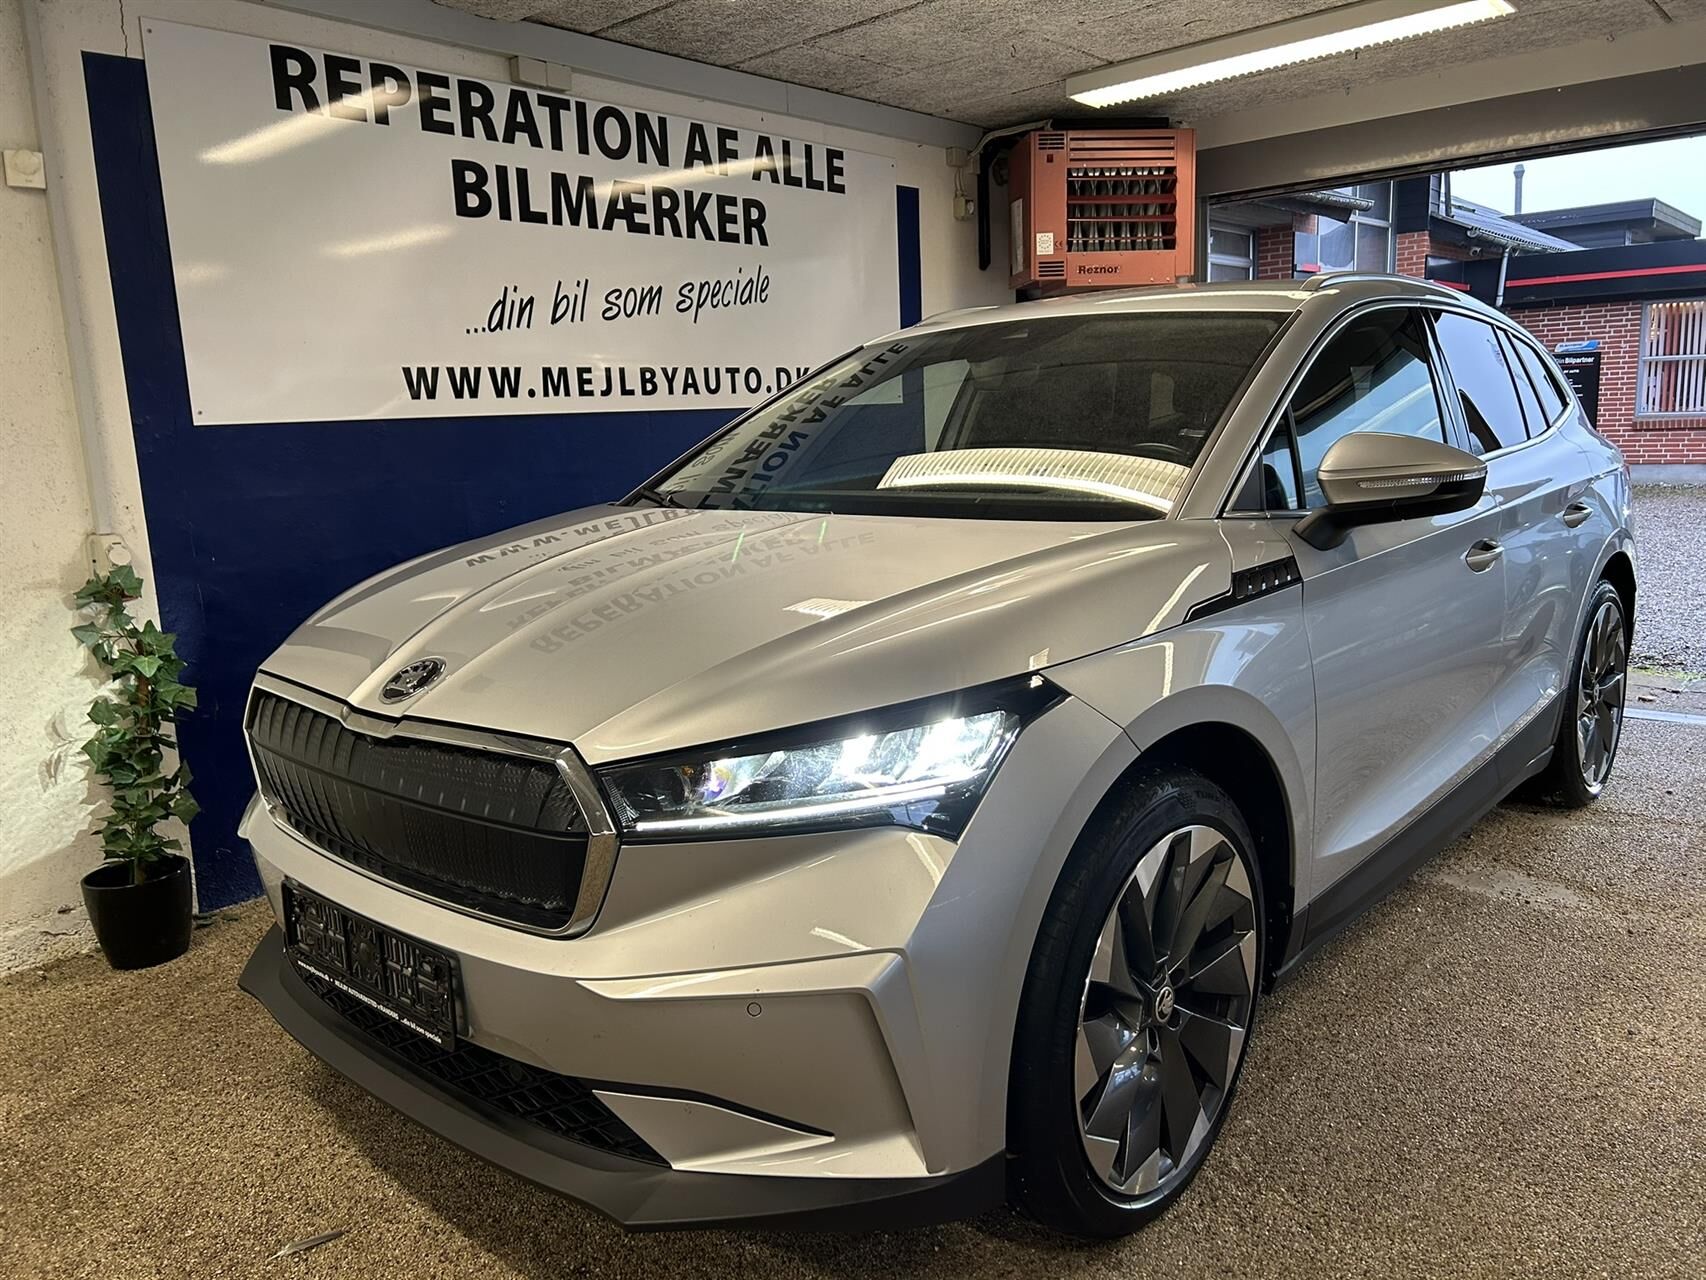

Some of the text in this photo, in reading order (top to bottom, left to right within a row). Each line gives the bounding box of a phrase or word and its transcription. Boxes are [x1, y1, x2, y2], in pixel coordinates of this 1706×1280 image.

[269, 44, 846, 195] REPERATION AF ALLE
[451, 159, 769, 247] BILMÆRKER
[550, 278, 589, 326] bil
[601, 285, 663, 321] som
[675, 264, 770, 324] speciale
[1077, 264, 1120, 275] Reznor
